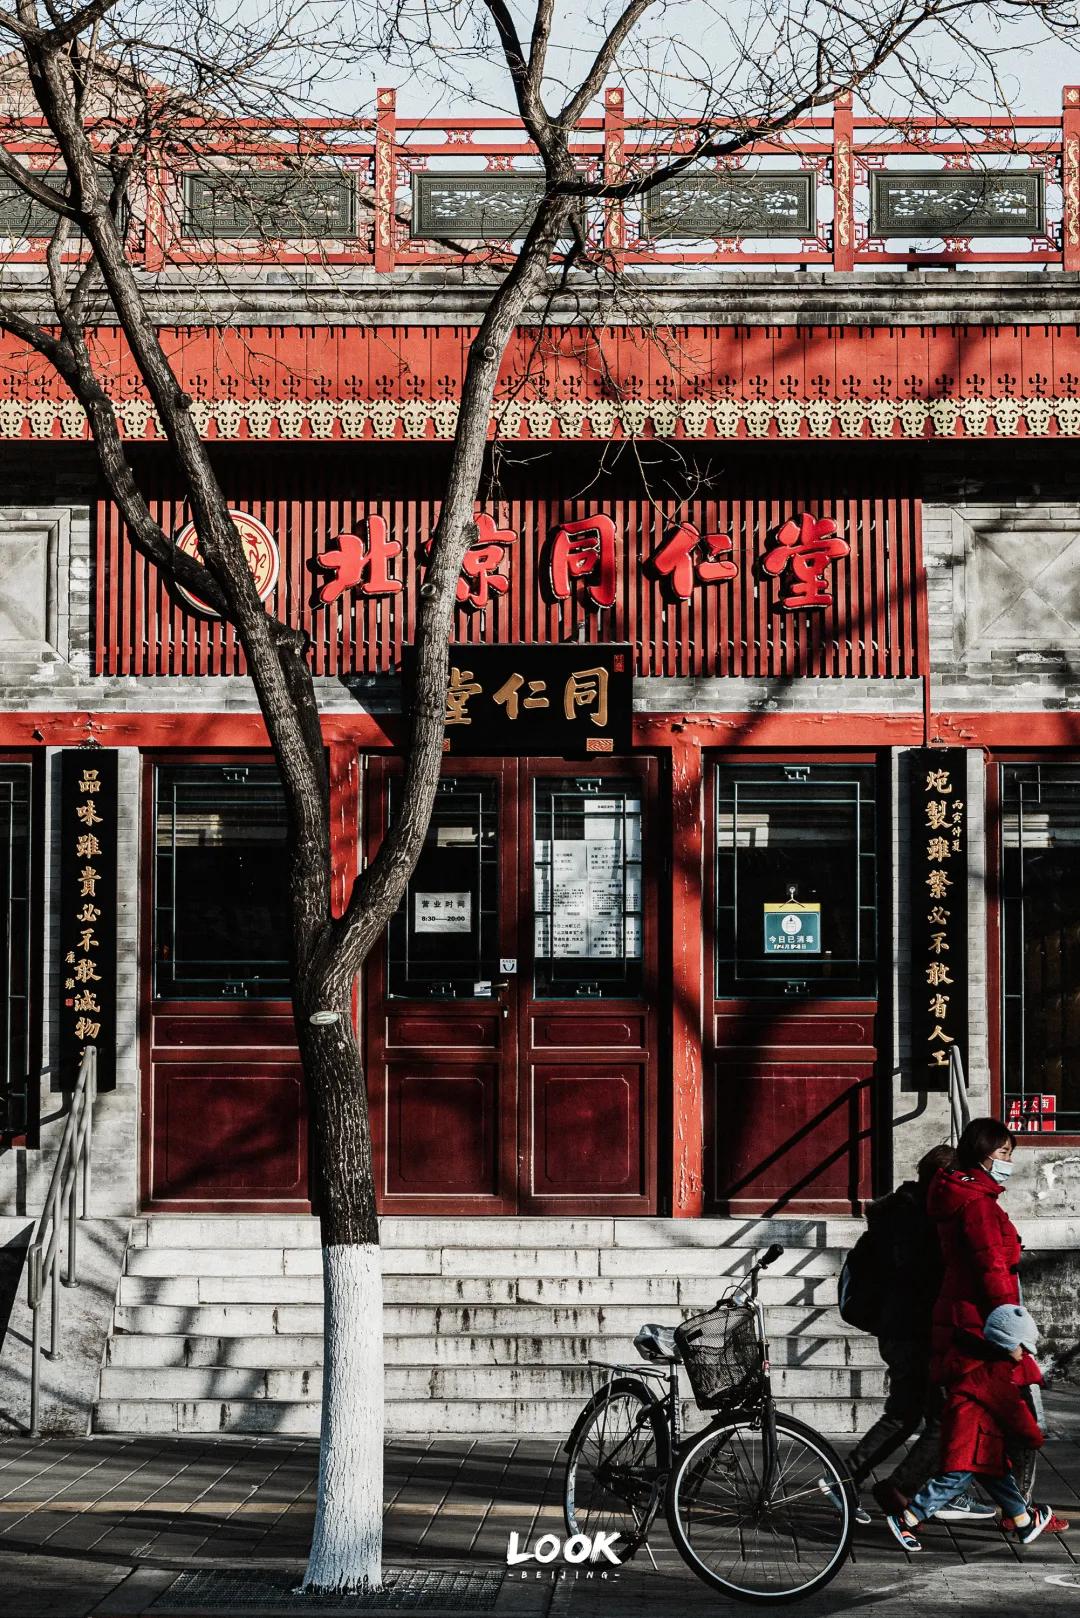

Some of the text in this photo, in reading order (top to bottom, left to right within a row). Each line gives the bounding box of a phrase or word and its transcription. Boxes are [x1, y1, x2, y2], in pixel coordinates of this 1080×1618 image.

[317, 512, 850, 609] 北京同仁堂
[444, 667, 608, 727] 同仁堂
[74, 769, 103, 1066] 品味雖貴必不敢減物
[421, 900, 465, 909] 营业时间
[768, 935, 814, 944] 今日已消毒
